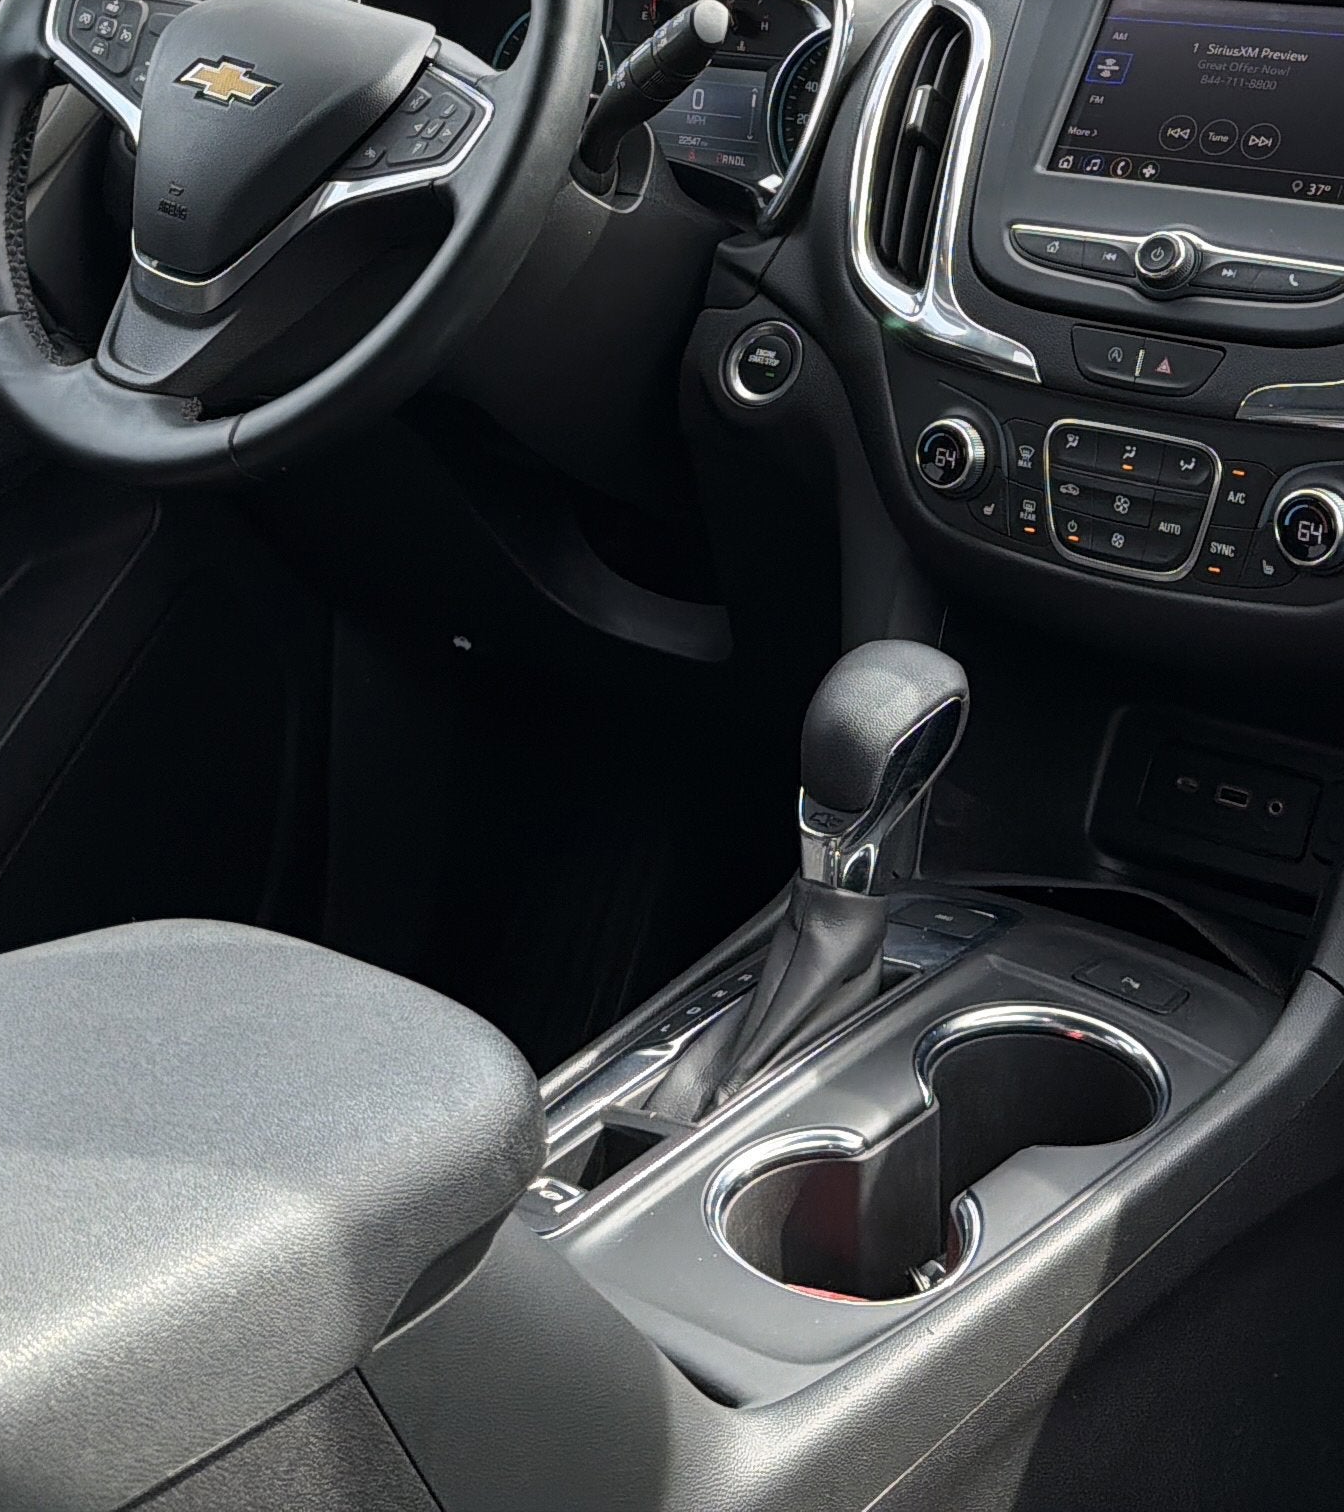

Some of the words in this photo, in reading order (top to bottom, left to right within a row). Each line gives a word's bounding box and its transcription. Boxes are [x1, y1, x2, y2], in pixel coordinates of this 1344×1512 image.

[761, 21, 769, 31] H
[1112, 31, 1129, 41] AM
[1206, 43, 1259, 58] SiriusXM
[1261, 47, 1309, 63] Preview
[1197, 59, 1228, 72] Great
[1229, 60, 1261, 74] Offer
[804, 81, 818, 93] 40
[692, 88, 705, 110] 0
[1089, 94, 1105, 105] FM
[686, 114, 707, 125] MPH
[1067, 125, 1092, 137] More
[1208, 132, 1229, 144] Tune
[935, 447, 956, 469] 64
[1017, 459, 1032, 469] MAX
[1227, 490, 1247, 505] A/C
[1019, 511, 1037, 521] REAR
[1158, 521, 1182, 536] AUTO
[1297, 520, 1323, 545] 64
[1209, 541, 1236, 558] SYNC
